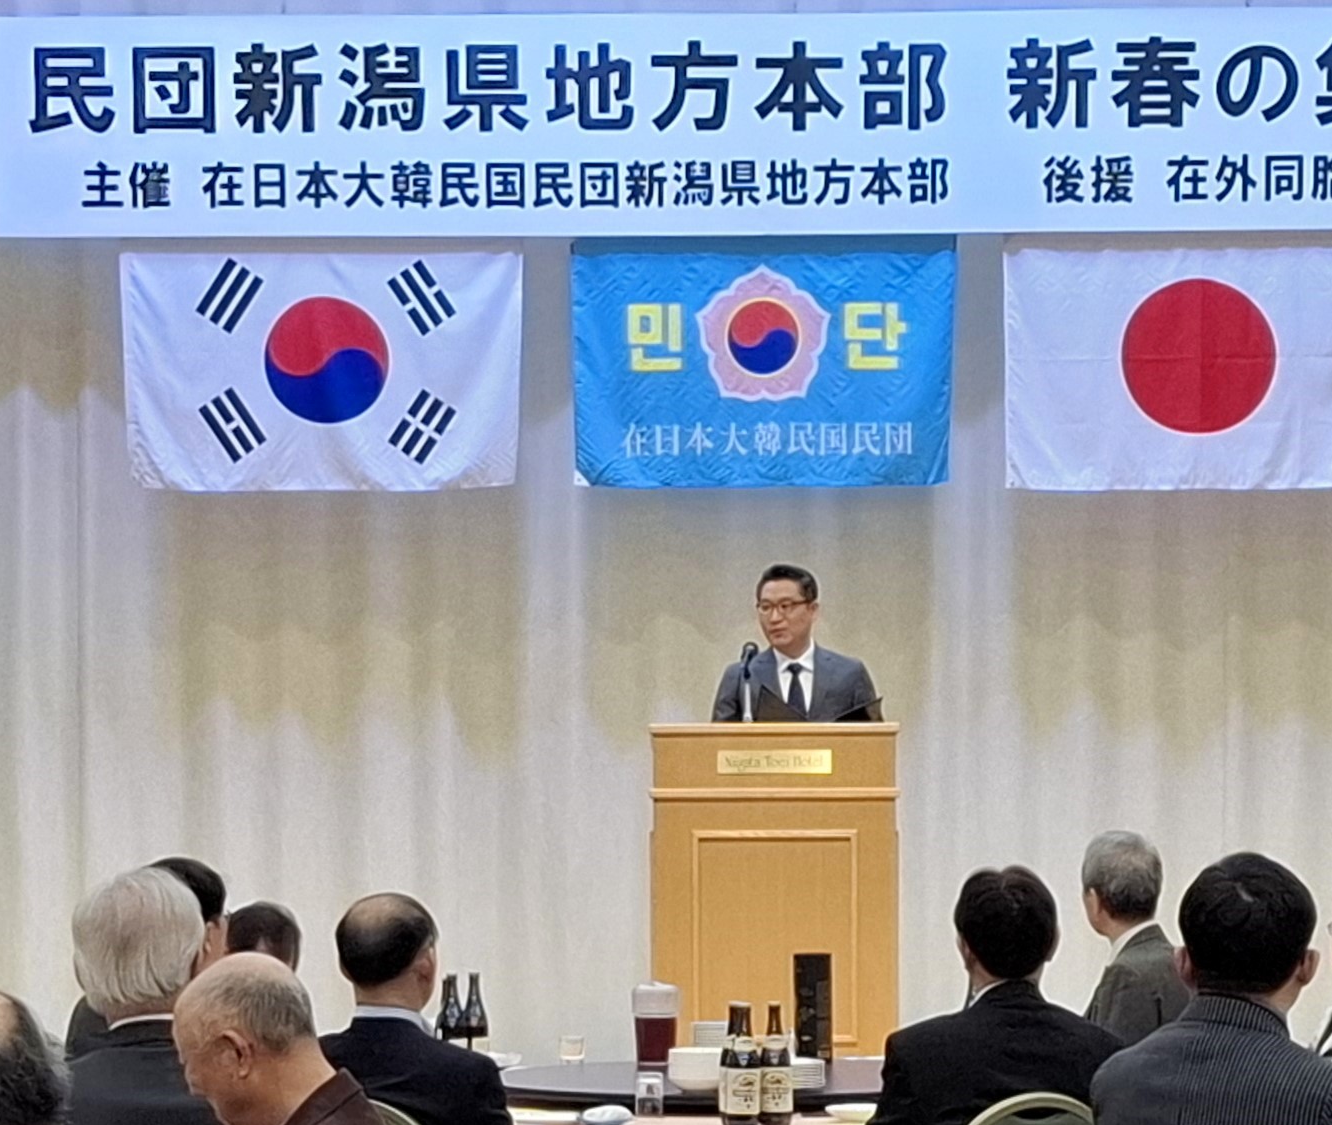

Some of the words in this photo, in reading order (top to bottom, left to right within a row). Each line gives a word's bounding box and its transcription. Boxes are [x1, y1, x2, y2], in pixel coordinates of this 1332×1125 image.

[29, 41, 946, 135] 民団新潟県地方本部
[82, 160, 171, 209] 主催
[202, 158, 949, 209] 在日本大韓民国民団新潟県地方本部
[1043, 154, 1134, 204] 後援
[627, 303, 683, 371] 민
[843, 302, 908, 370] 단
[622, 421, 913, 457] 在日本大韓民国民団
